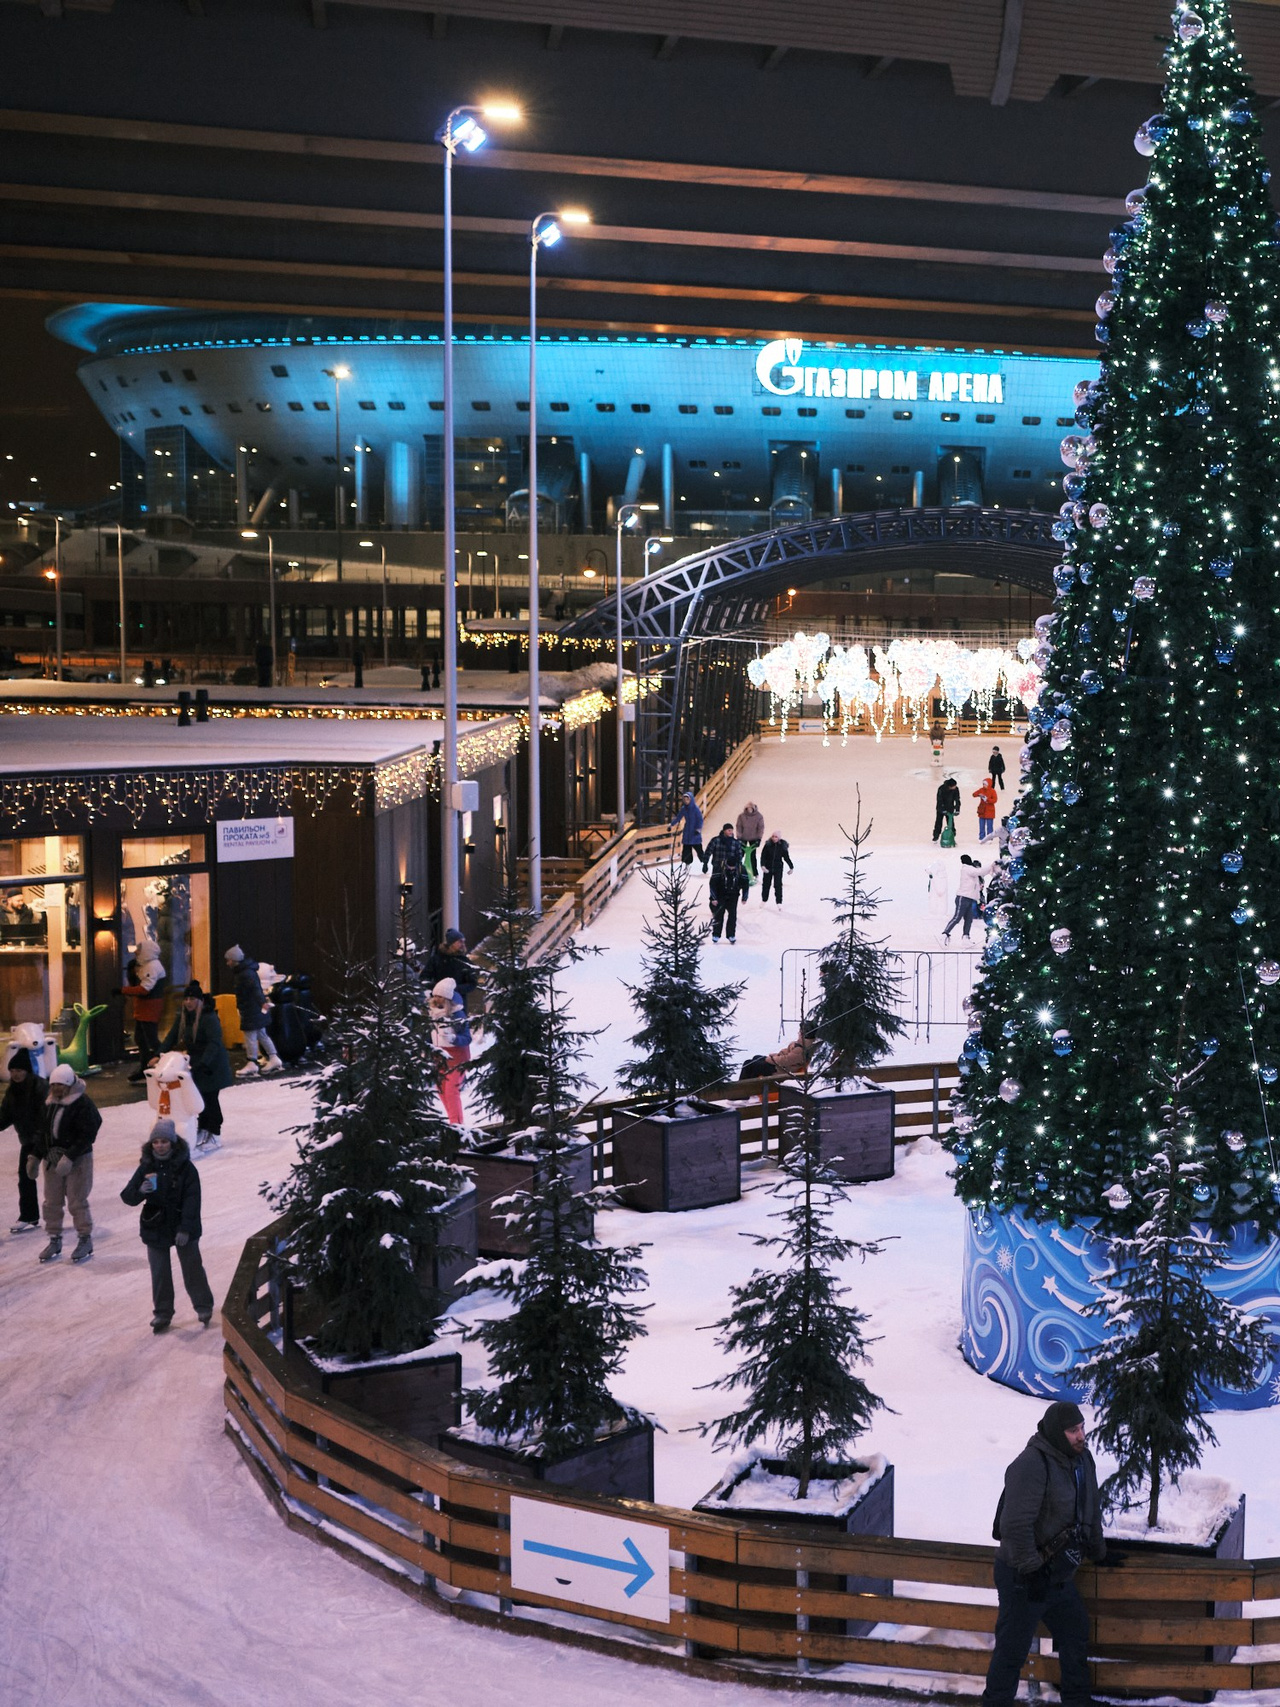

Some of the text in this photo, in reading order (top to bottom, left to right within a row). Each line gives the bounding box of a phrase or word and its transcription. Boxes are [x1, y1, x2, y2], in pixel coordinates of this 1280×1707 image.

[804, 367, 1004, 404] ГАЗПРОМ АРЕНА
[223, 826, 265, 834] ПАВИЛЬОН
